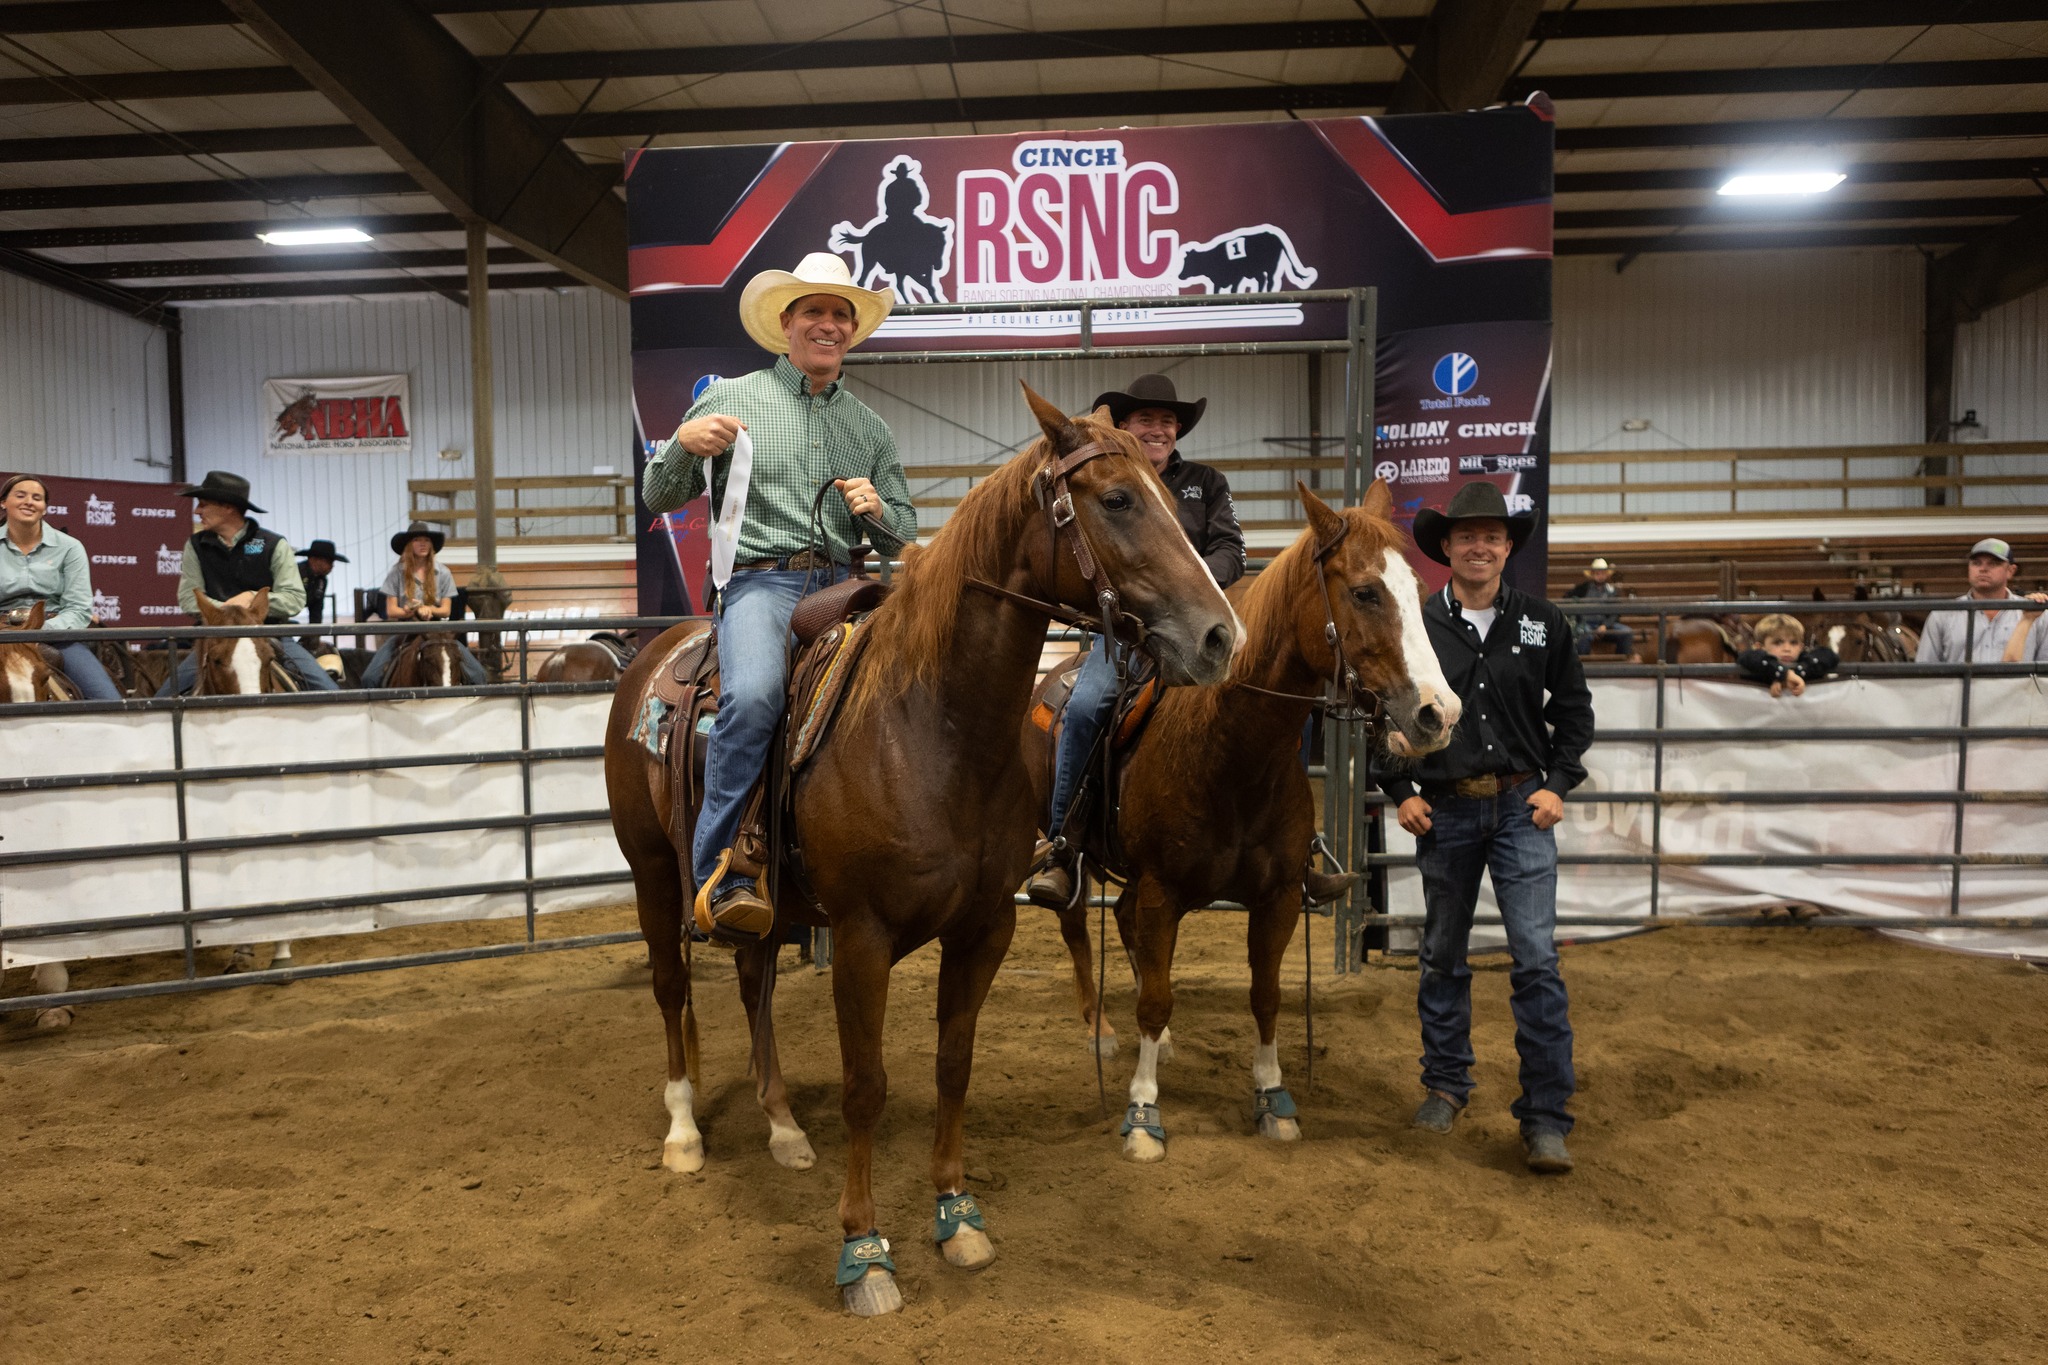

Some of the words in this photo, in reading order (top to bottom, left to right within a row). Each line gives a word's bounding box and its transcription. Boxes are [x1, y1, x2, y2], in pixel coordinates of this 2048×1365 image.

[1019, 148, 1117, 167] CINCH
[964, 168, 1173, 284] RSNC
[1232, 241, 1241, 256] 1
[963, 289, 997, 302] RANCH
[999, 288, 1040, 302] SORTING
[1043, 286, 1088, 300] NATIONAL
[1093, 283, 1173, 299] CHAMPIONSHIPS
[968, 315, 982, 324] #1
[993, 315, 1039, 324] EQUINE
[1050, 312, 1097, 323] FAMIY
[1107, 310, 1148, 321] SPORT
[1420, 396, 1451, 410] Total
[1453, 394, 1491, 408] Feeds
[304, 394, 409, 440] NBHA
[1376, 420, 1450, 441] HOLIDAY
[1458, 422, 1537, 438] CINCH
[1376, 440, 1406, 449] AUTO
[1412, 438, 1450, 447] GROUP
[1400, 457, 1450, 477] LAREDO
[1459, 456, 1483, 468] Mil
[1496, 456, 1537, 468] Spec
[1400, 475, 1450, 484] CONVERSIONS
[86, 510, 116, 526] RSNC
[131, 507, 177, 518] CINCH
[91, 555, 138, 565] CINCH
[1520, 630, 1547, 647] RSNC
